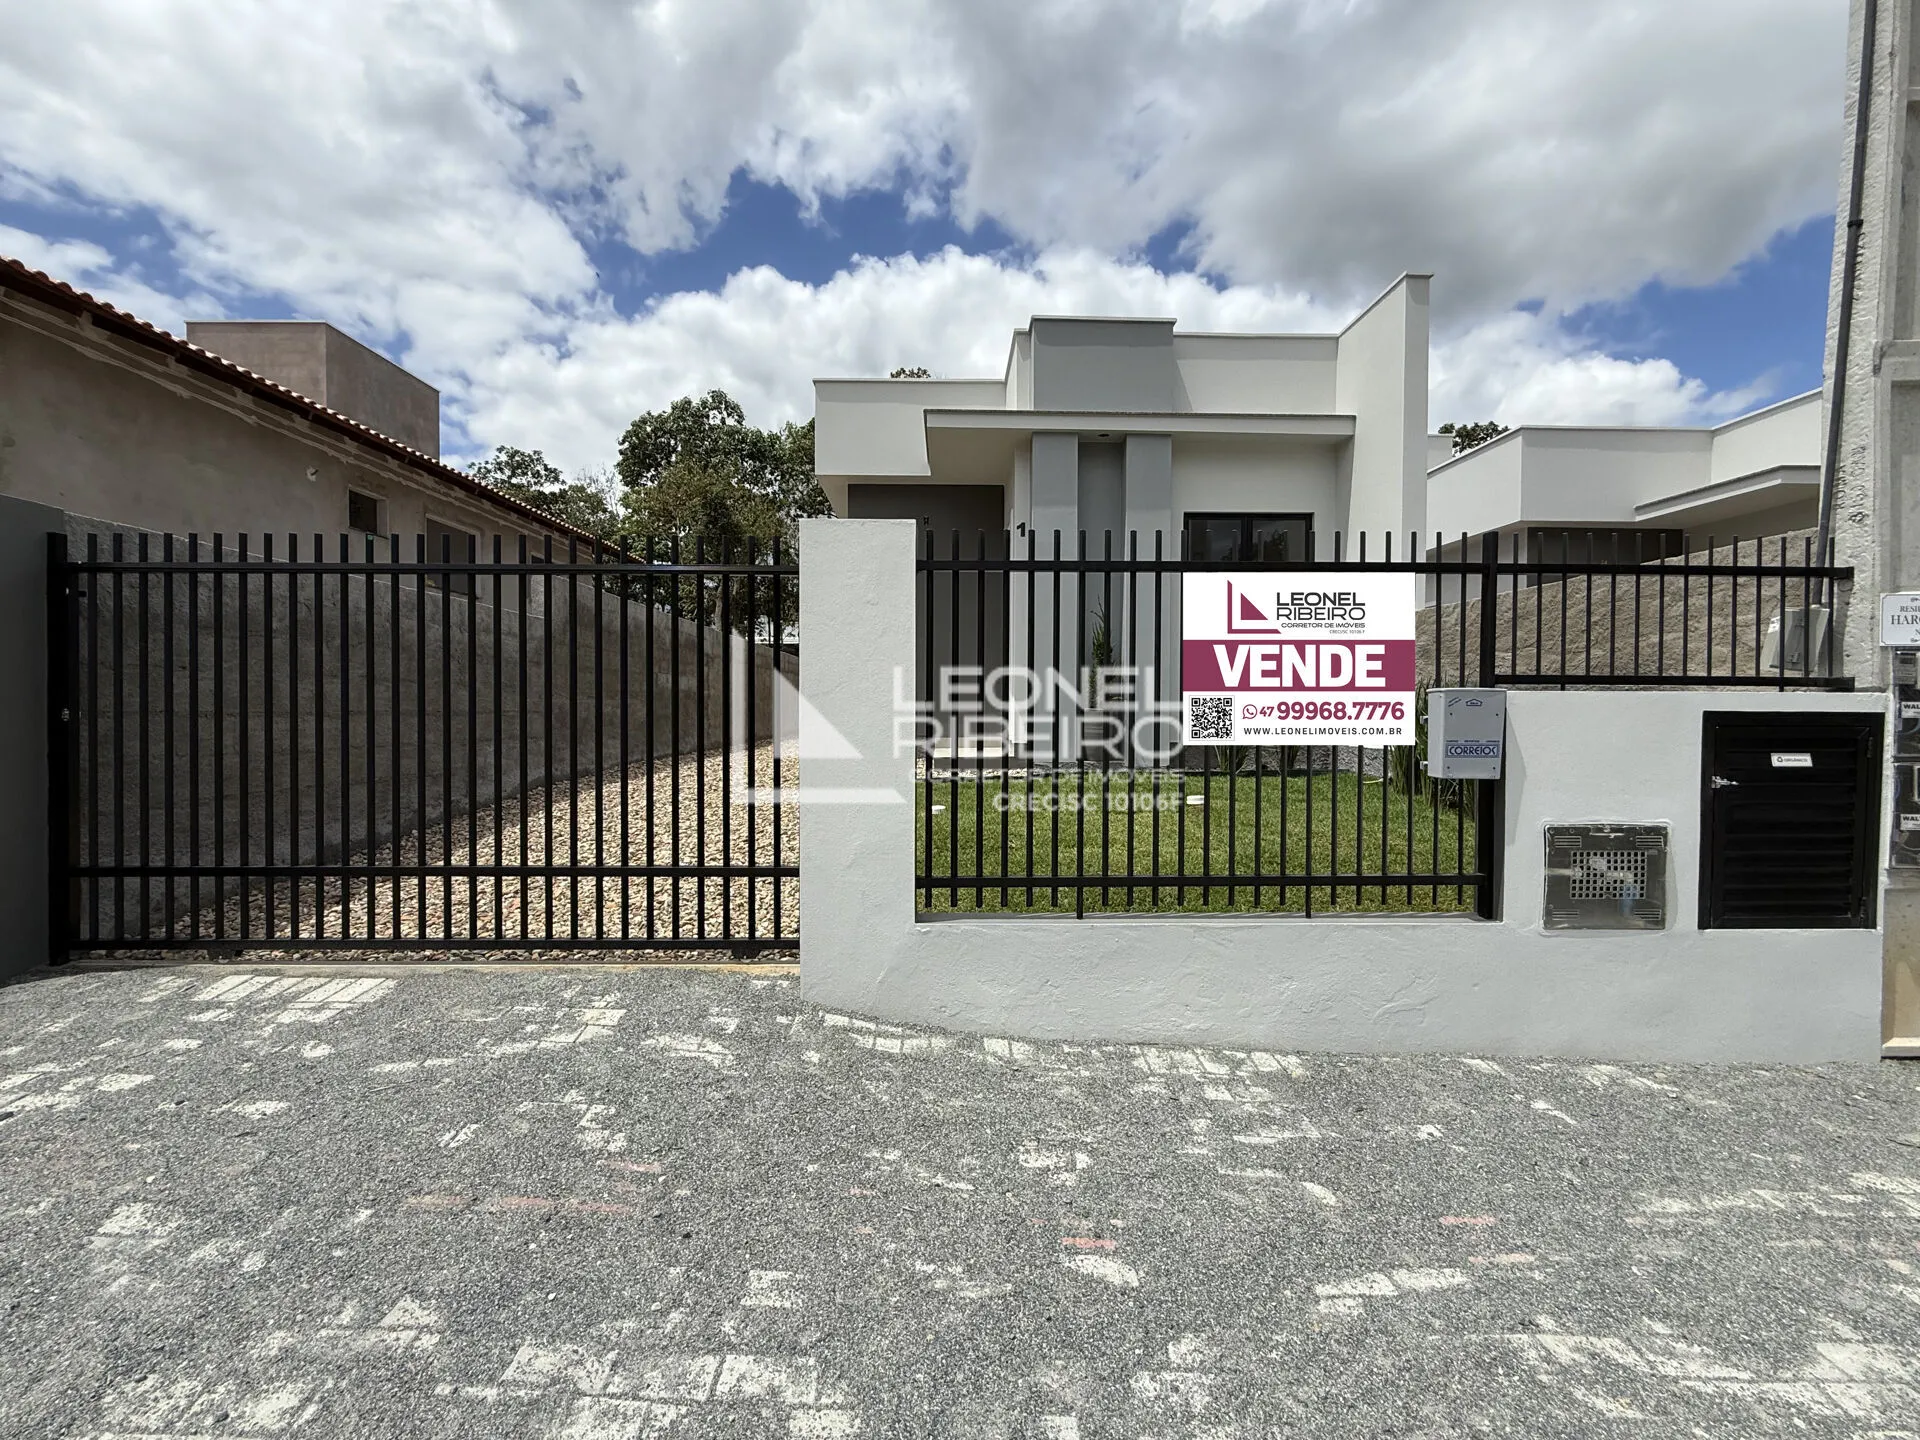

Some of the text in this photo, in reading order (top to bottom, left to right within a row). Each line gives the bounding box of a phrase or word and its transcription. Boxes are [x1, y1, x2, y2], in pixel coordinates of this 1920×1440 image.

[1016, 522, 1026, 537] 1
[1276, 592, 1366, 606] LEONEL
[1276, 607, 1366, 620] RIBEIRO
[1890, 614, 1920, 625] HAR
[1213, 644, 1386, 687] VENDE
[1259, 701, 1405, 721] 47 99968.7776
[1449, 746, 1496, 755] CORREIOS
